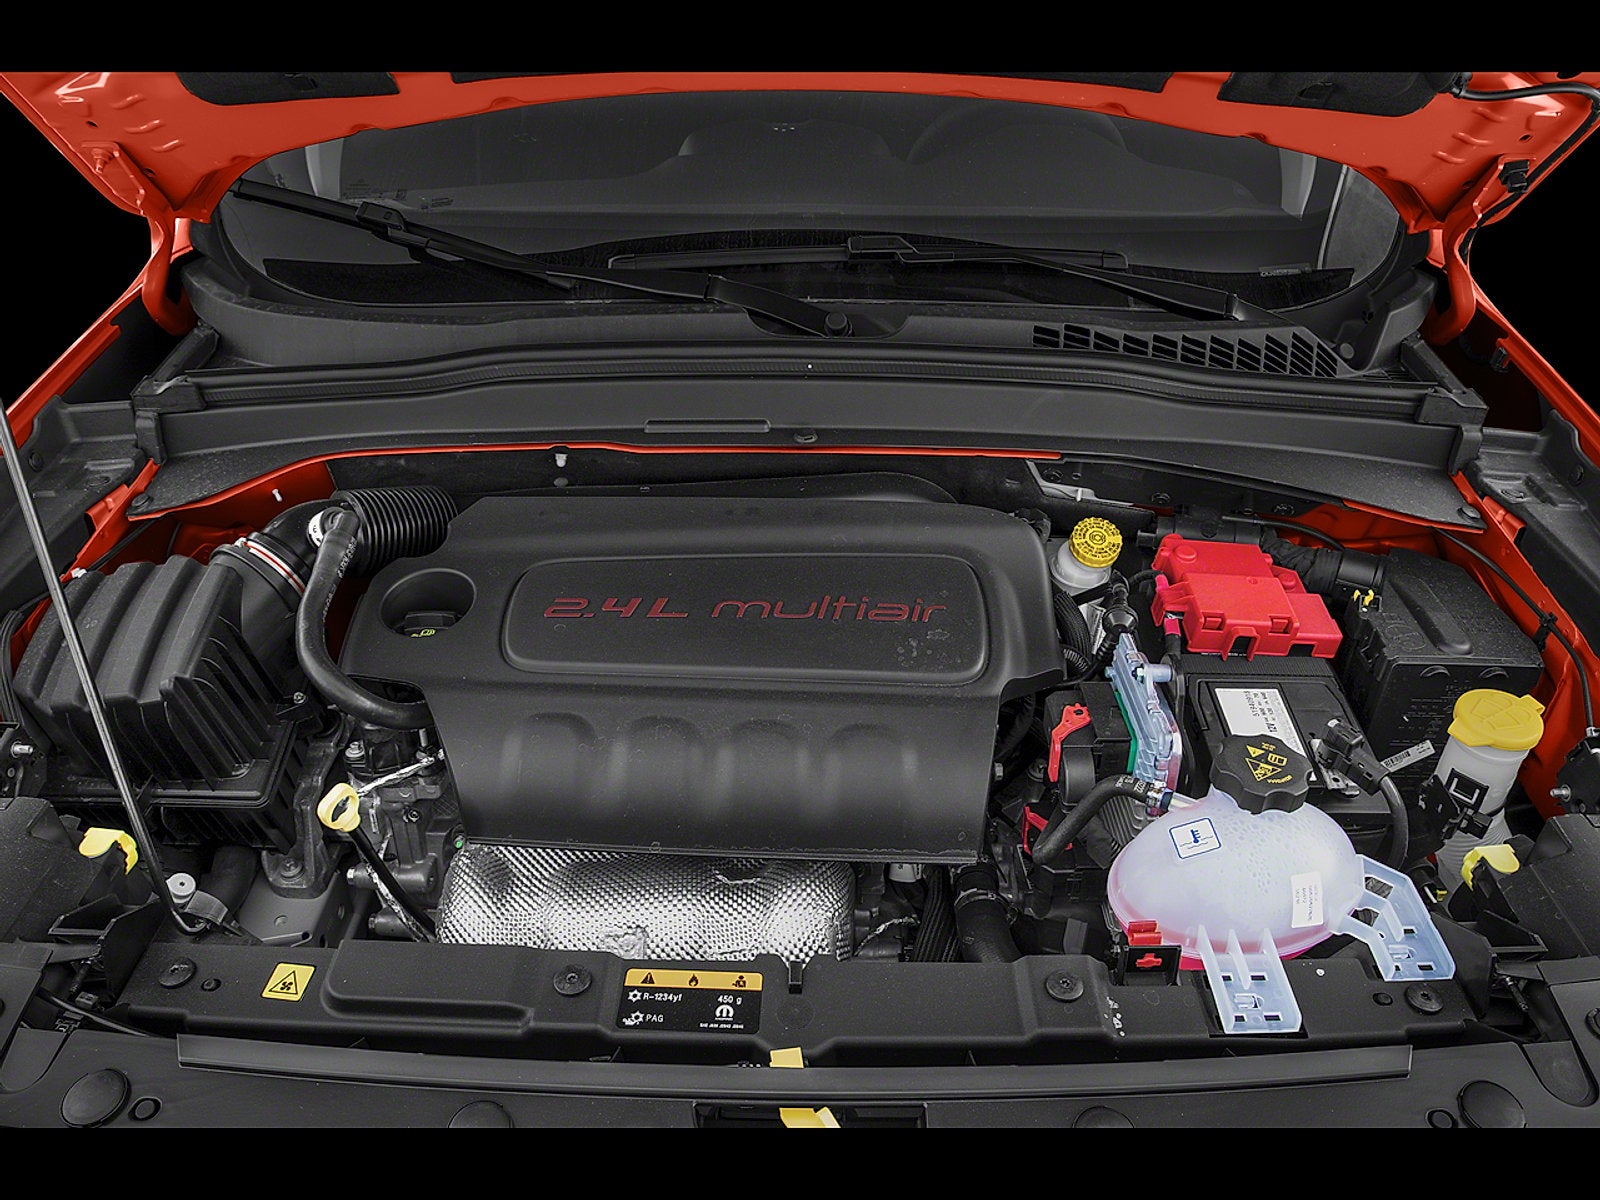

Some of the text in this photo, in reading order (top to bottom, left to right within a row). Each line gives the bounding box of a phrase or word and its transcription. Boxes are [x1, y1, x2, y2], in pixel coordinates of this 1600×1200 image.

[543, 595, 948, 623] 2.4L multiair
[717, 994, 743, 1006] 450 g
[645, 1013, 664, 1023] PAG
